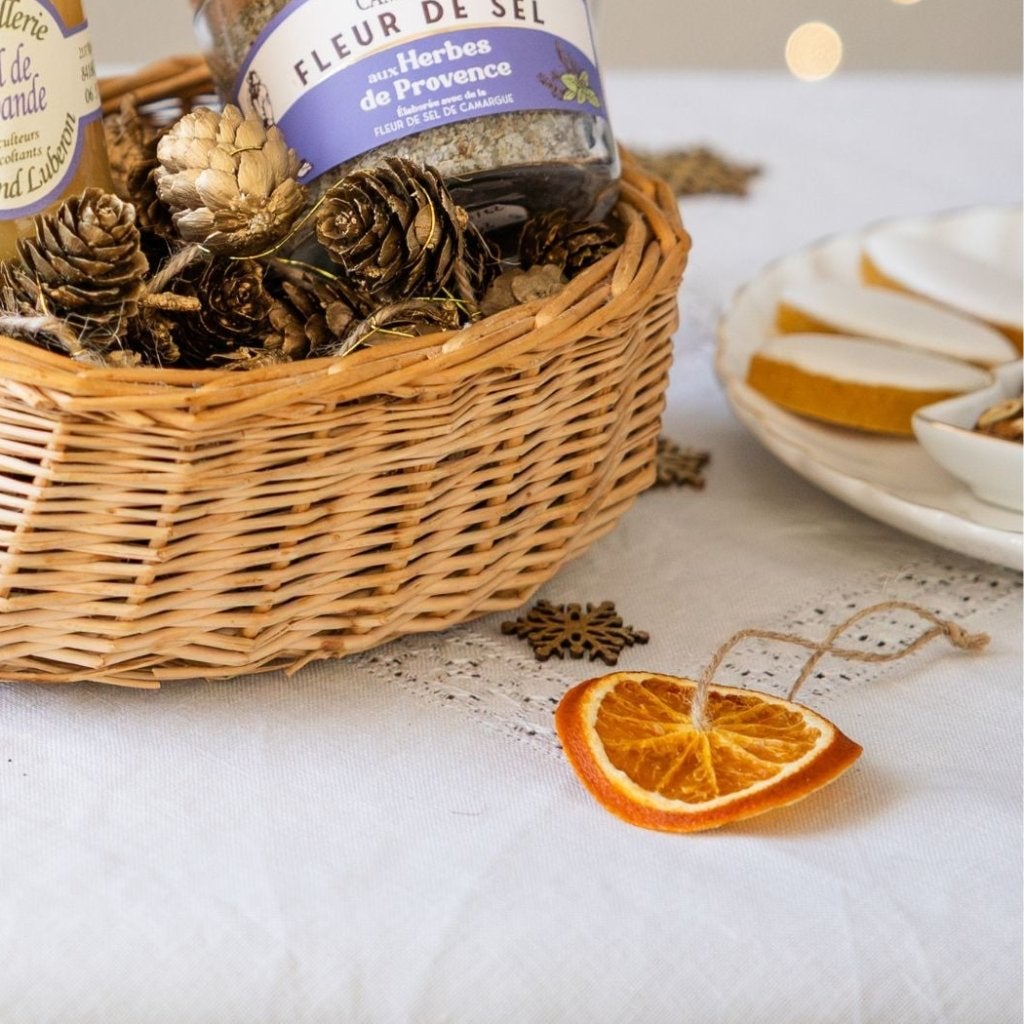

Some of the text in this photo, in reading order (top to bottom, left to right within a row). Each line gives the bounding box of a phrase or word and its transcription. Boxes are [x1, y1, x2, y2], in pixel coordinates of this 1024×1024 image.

[11, 43, 31, 84] de
[293, 12, 401, 86] FLEUR
[368, 39, 492, 84] aux Herbes
[359, 61, 513, 112] de Provence
[374, 93, 514, 136] FLEUR DE SEL DE CAMARGUE
[27, 112, 76, 193] Luberon
